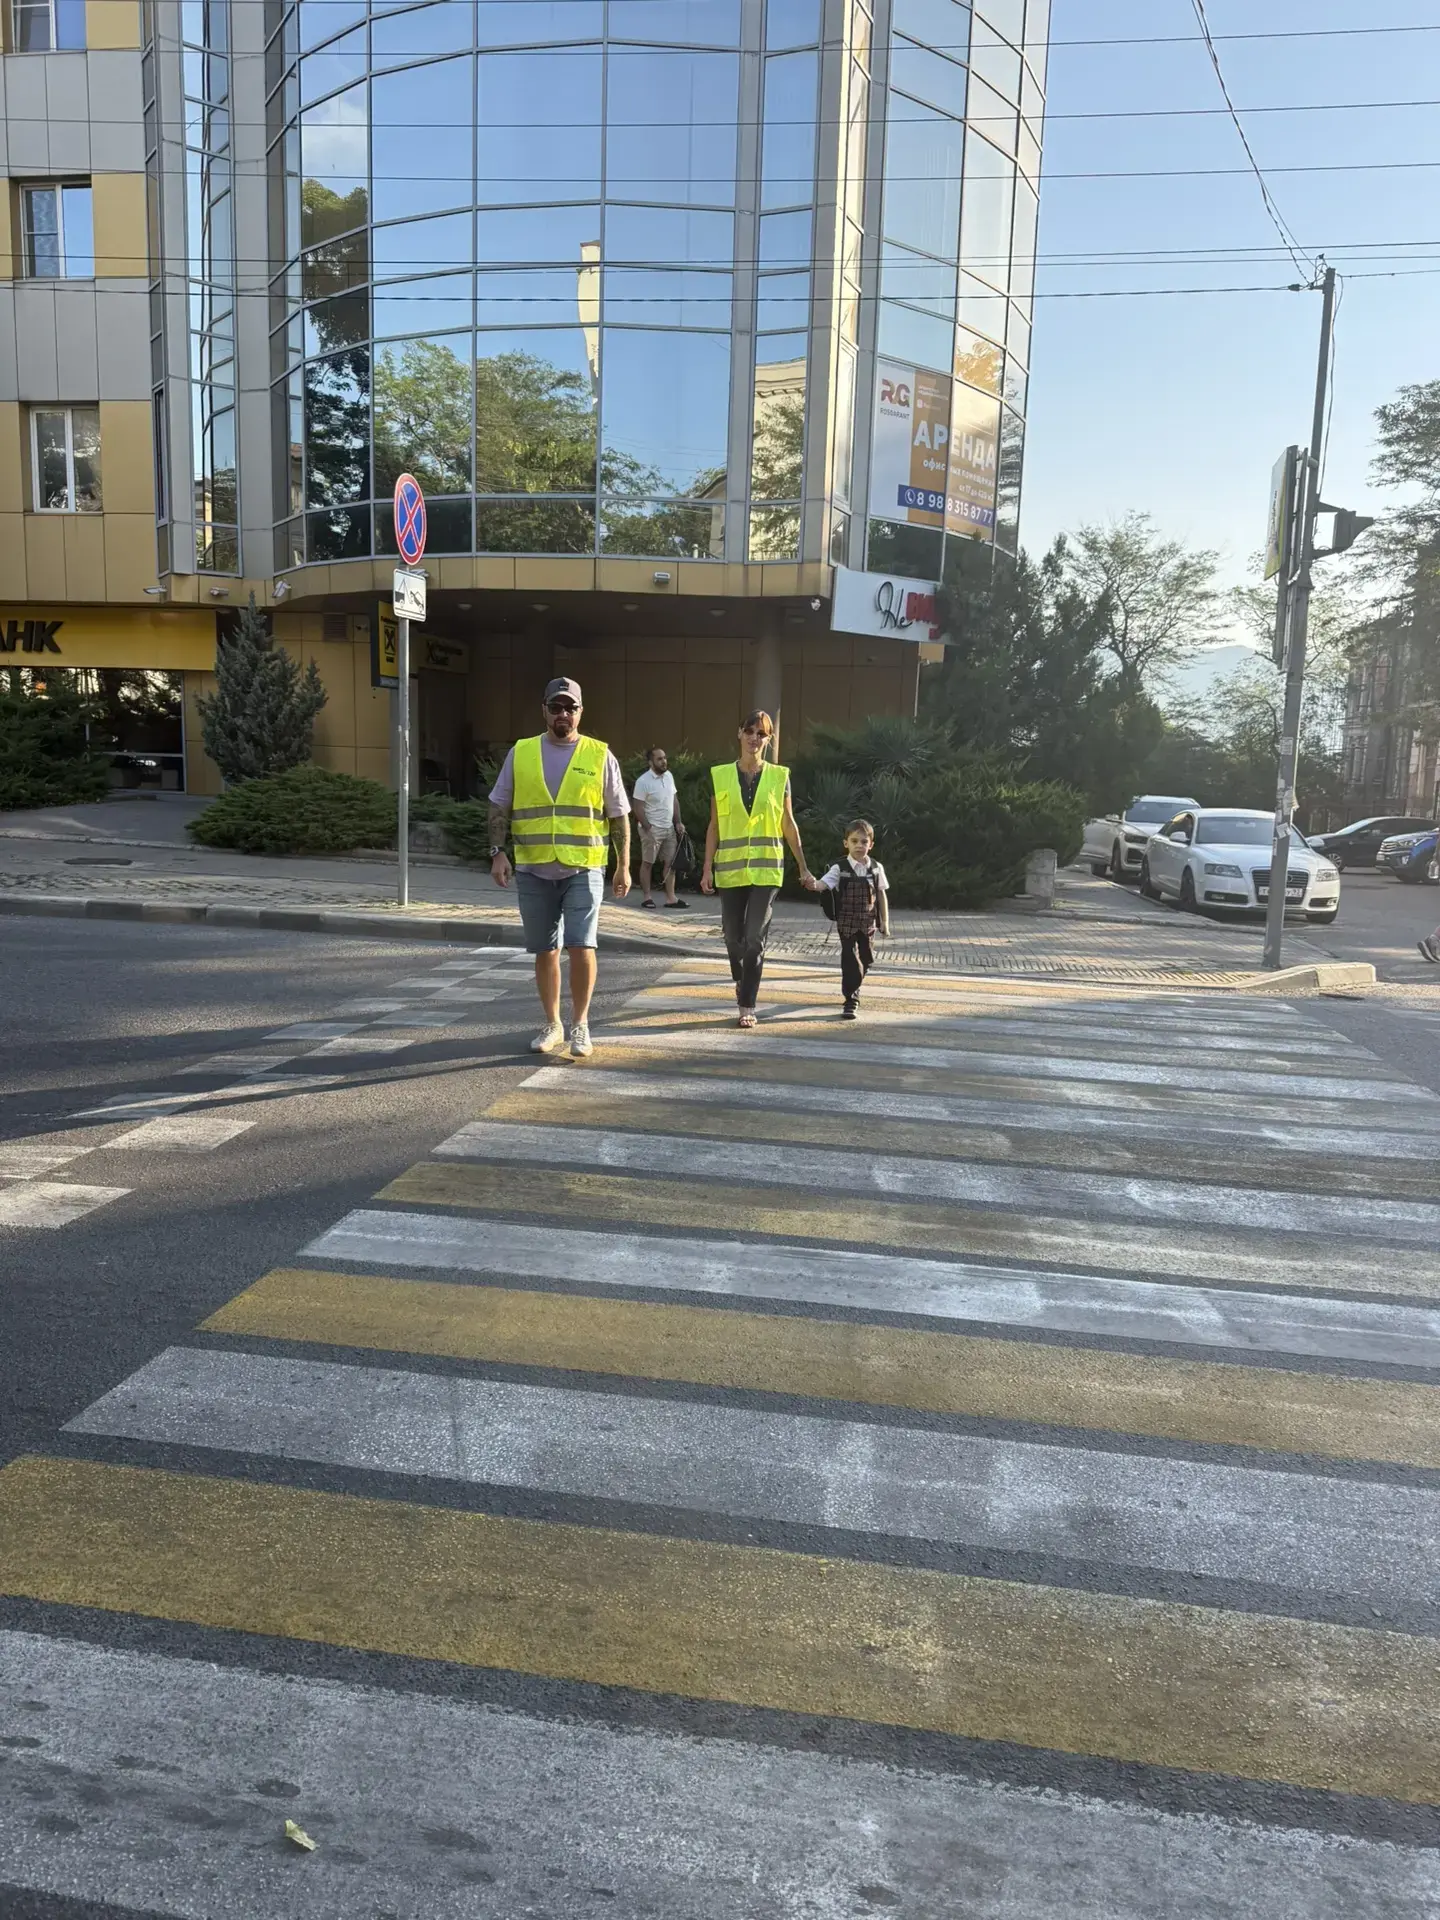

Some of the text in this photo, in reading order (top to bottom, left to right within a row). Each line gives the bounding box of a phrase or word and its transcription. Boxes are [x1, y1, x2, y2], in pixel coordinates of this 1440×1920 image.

[913, 419, 996, 471] АРЕНДА
[917, 491, 925, 506] 8
[954, 499, 969, 517] 315
[970, 505, 981, 520] 87
[982, 509, 994, 524] 77
